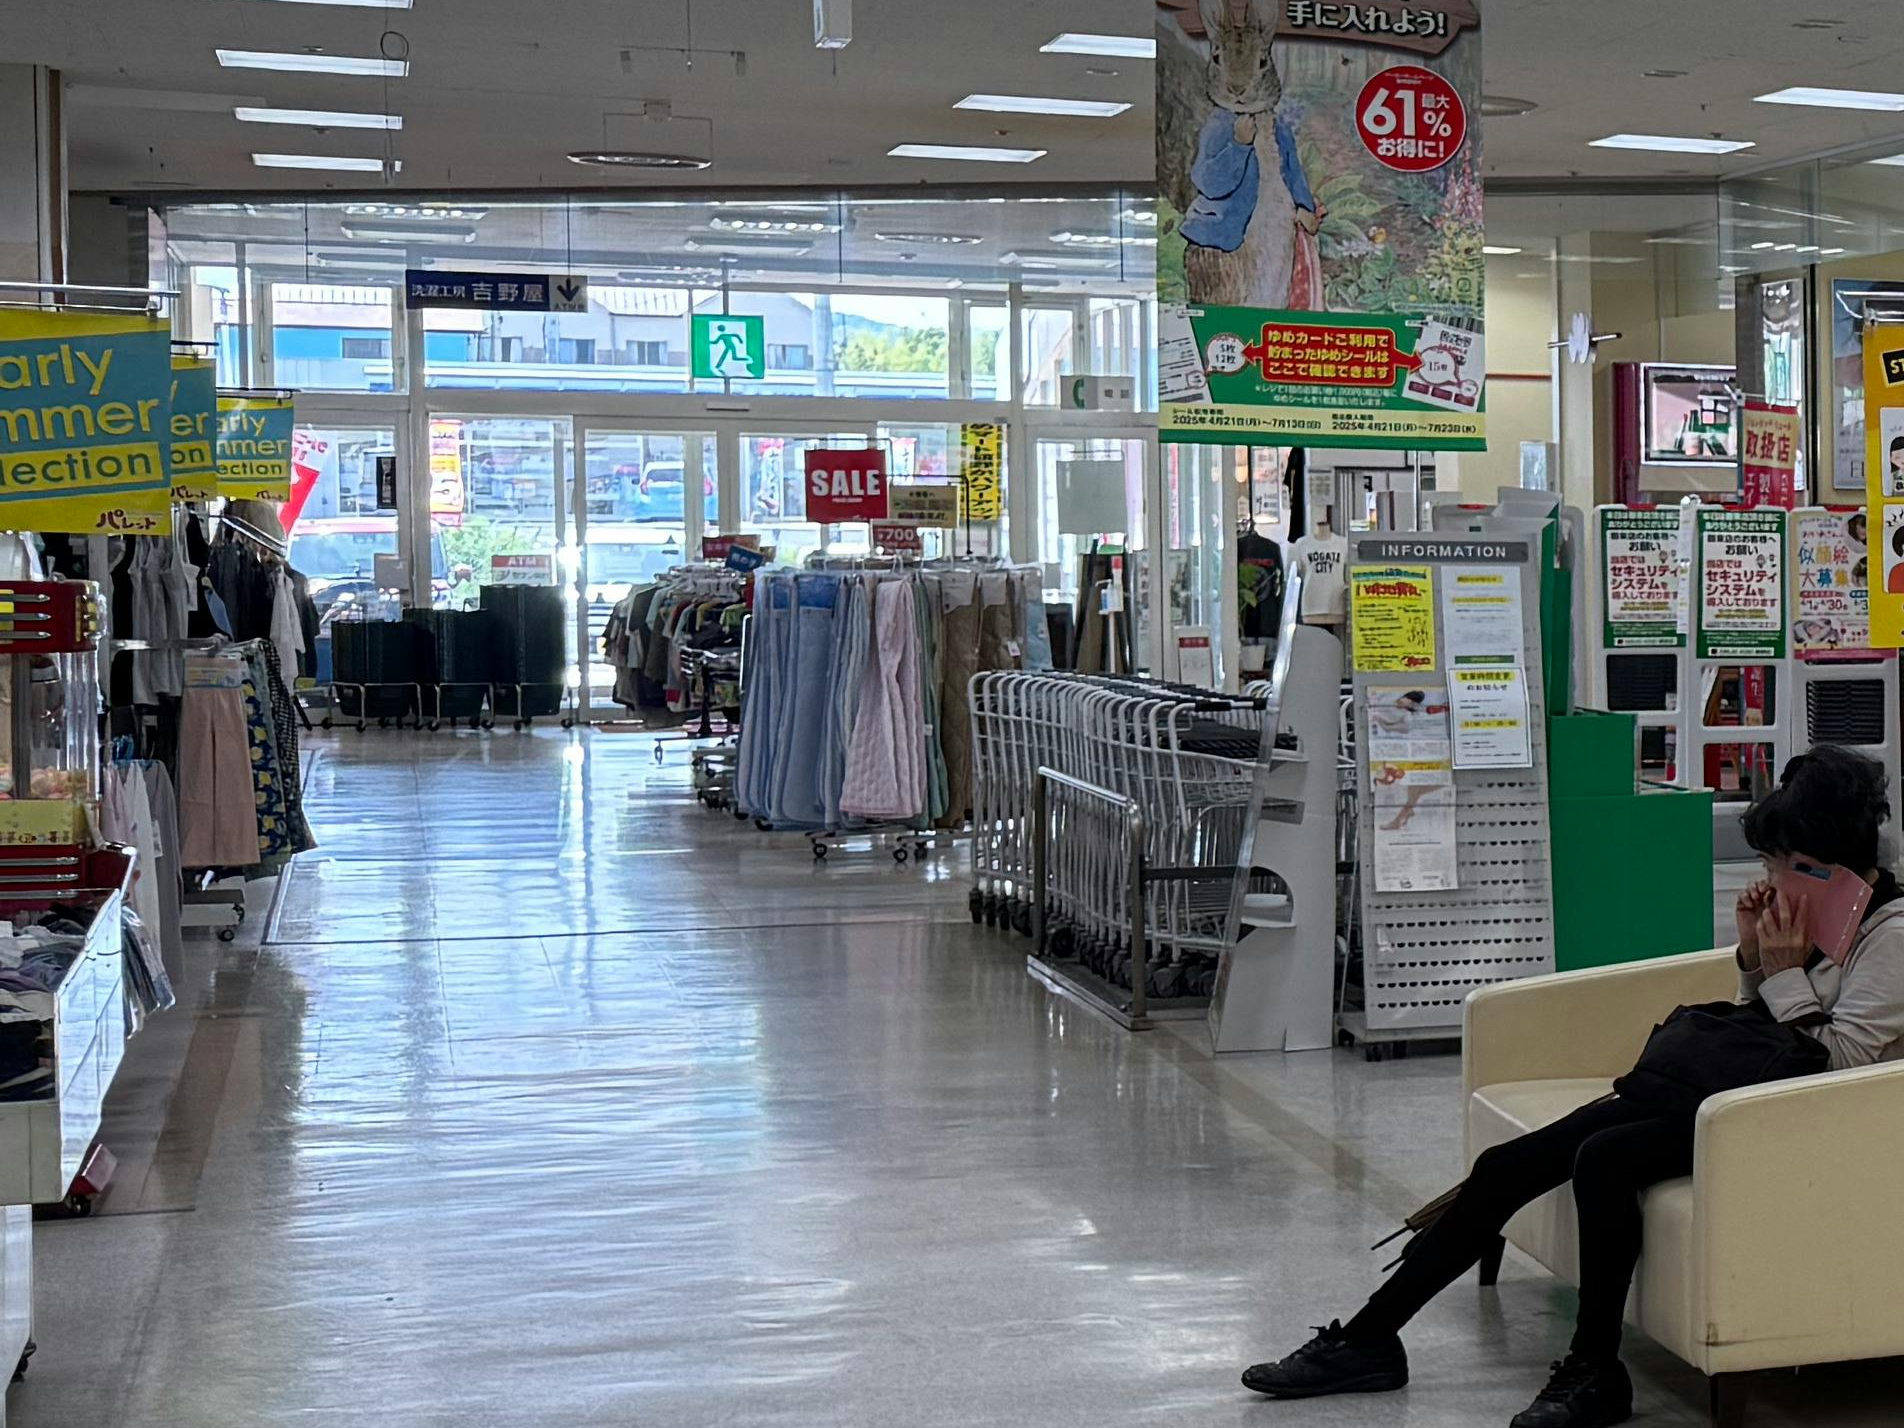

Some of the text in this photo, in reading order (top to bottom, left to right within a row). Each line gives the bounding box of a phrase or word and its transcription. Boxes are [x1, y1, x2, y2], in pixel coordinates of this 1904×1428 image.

[1287, 0, 1446, 36] 手に入れよう!
[1420, 91, 1451, 109] 最大
[1376, 138, 1445, 159] お得に!
[811, 468, 881, 496] SALE
[95, 508, 157, 531] パレット
[1381, 544, 1507, 558] INFORMATION
